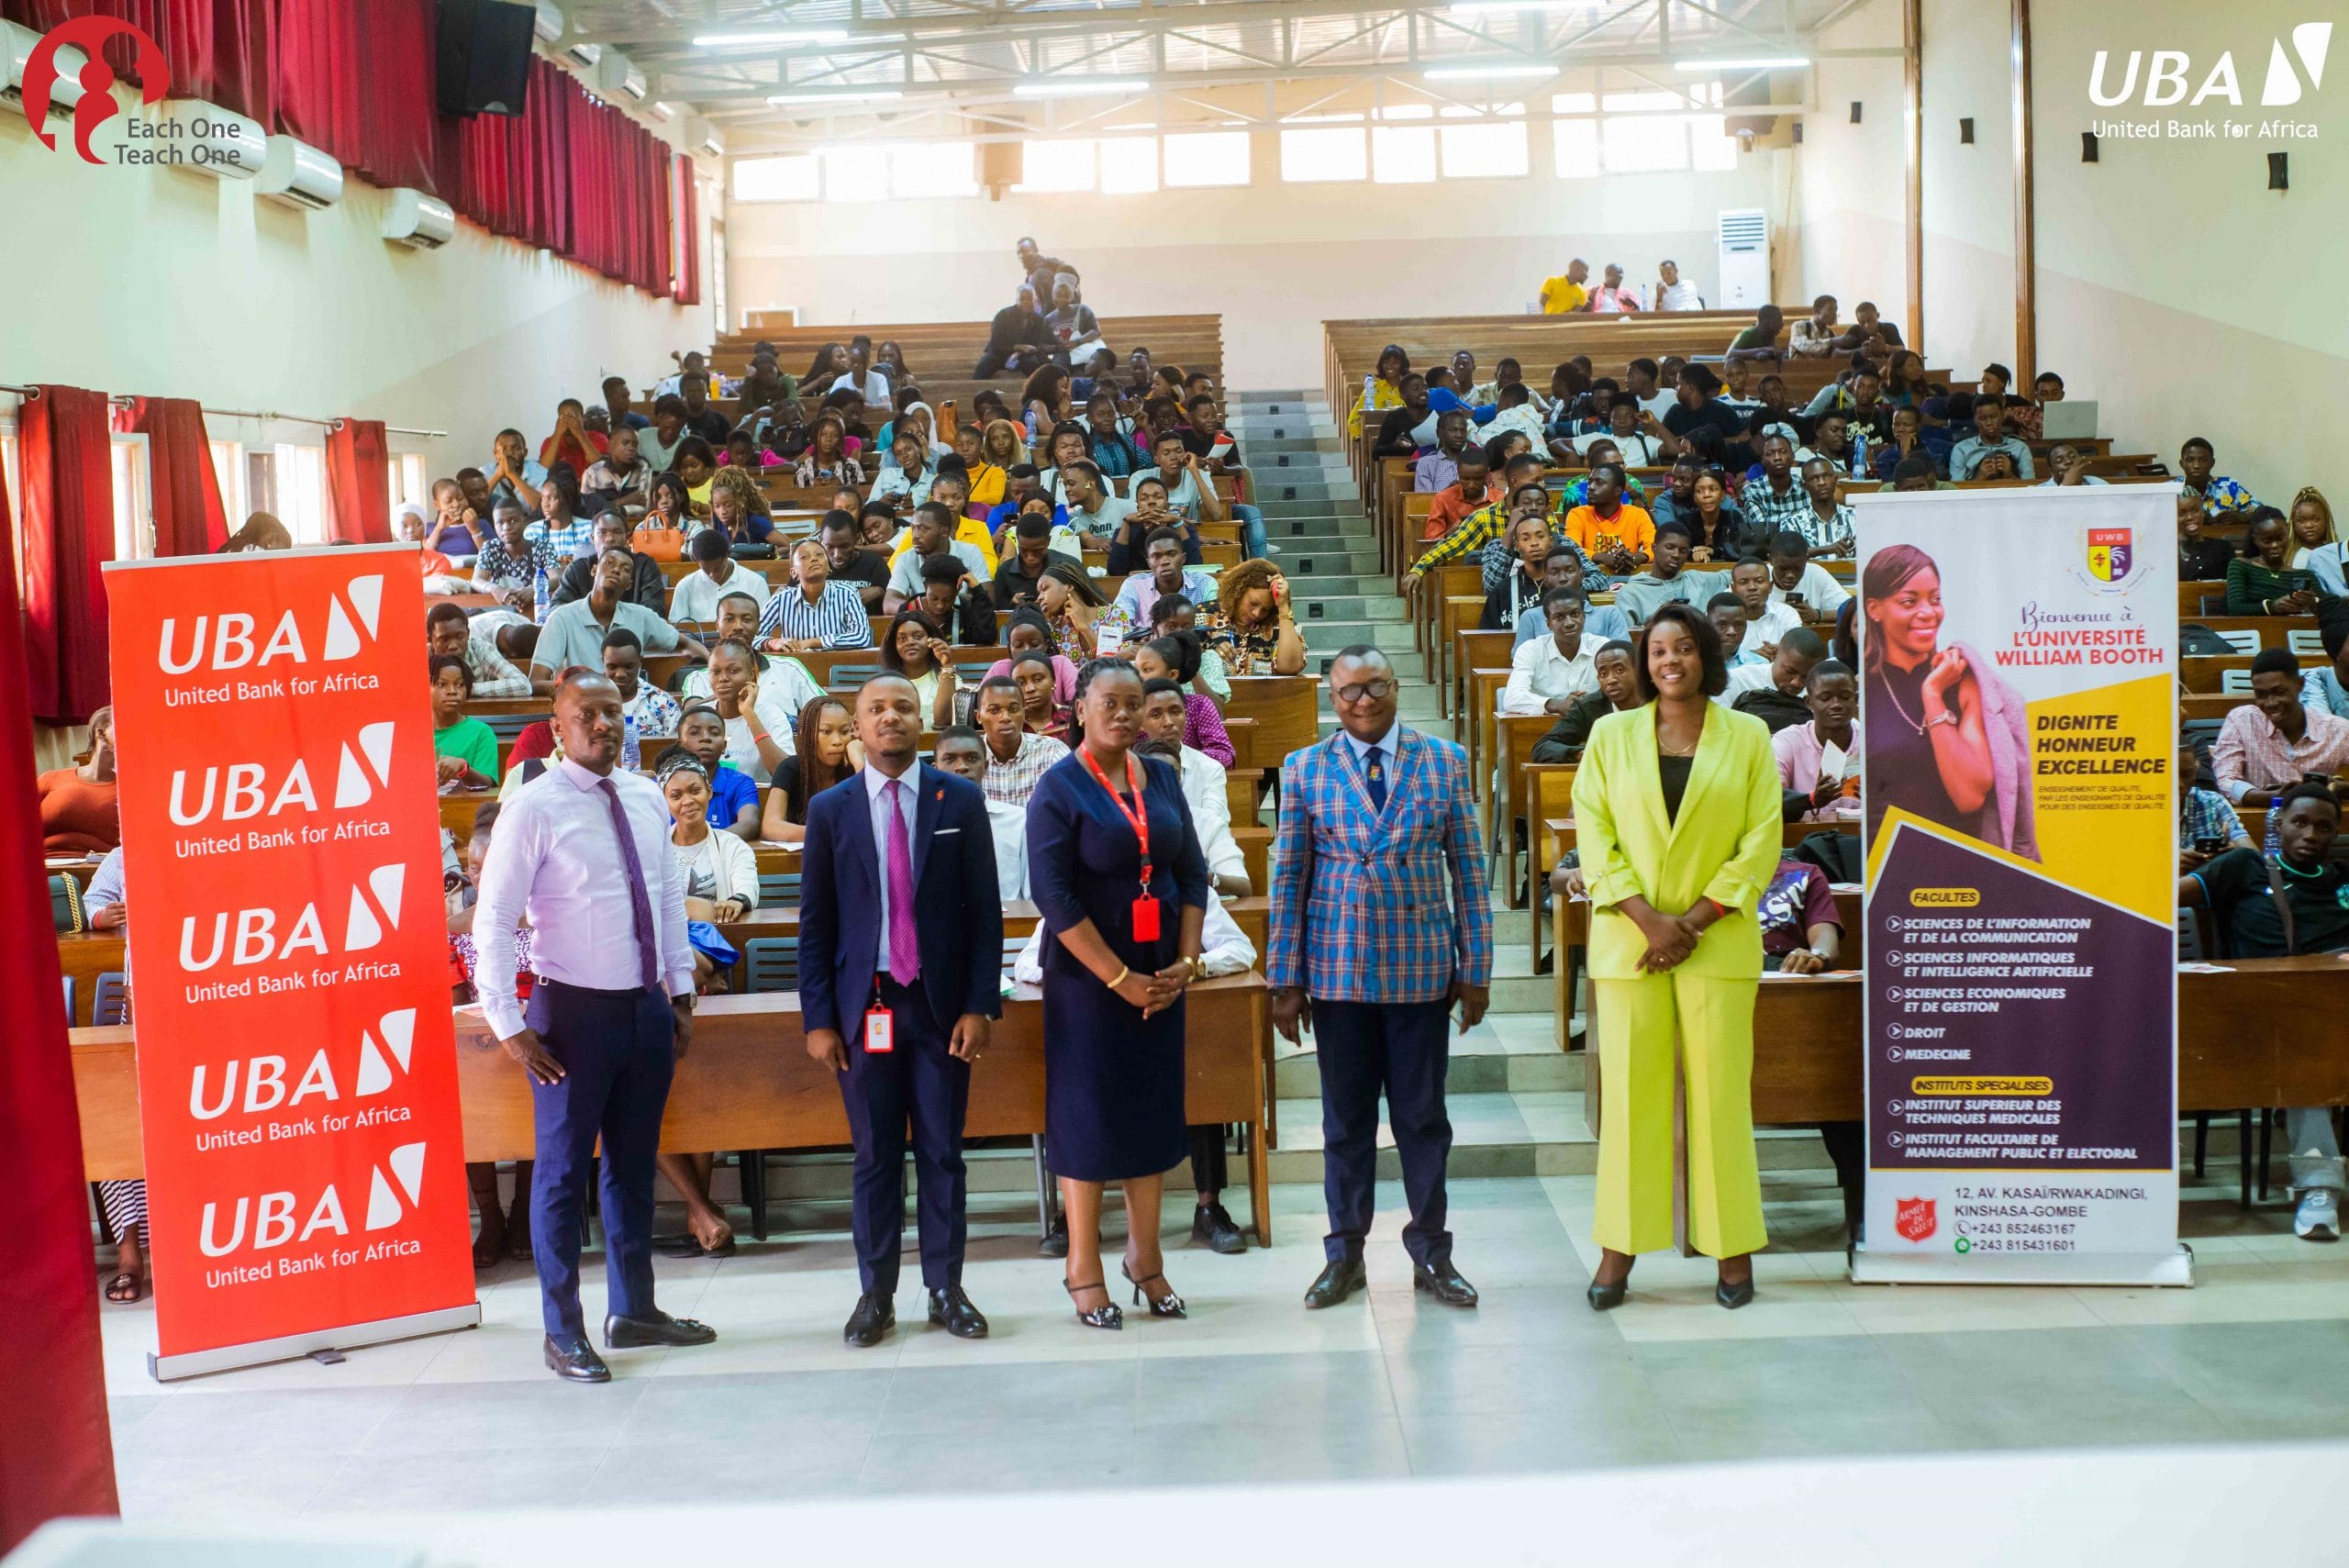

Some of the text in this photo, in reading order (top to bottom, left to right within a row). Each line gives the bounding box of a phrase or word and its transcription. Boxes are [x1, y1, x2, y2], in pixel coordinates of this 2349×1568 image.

[2096, 533, 2124, 541] UWB
[2021, 601, 2135, 633] Bienvenue à
[158, 609, 306, 675] UBA
[1995, 648, 2164, 666] WILLIAM BOOTH
[165, 673, 379, 707] United Bank for Africa
[2036, 715, 2120, 730] DIGNITE
[2036, 737, 2137, 752] HONNEUR
[2036, 759, 2167, 775] EXCELLENCE
[169, 758, 318, 827] UBA
[175, 820, 391, 858] United Bank for Africa
[1913, 891, 1976, 903] FACULTES
[1904, 918, 1964, 929] SCIENCES
[1966, 918, 1984, 929] DE
[179, 902, 329, 973] UBA
[1904, 932, 2078, 943] ET DE LA COMMUNICATION
[1904, 952, 2076, 964] SCIENCES INFORMATIQUES
[1904, 966, 2094, 977] ET INTELLIGENCE ARTIFICIELLE
[185, 962, 401, 1004] United Bank for Africa
[1904, 987, 2066, 1000] SCIENCES ECONOMIQUES
[1904, 1002, 1999, 1013] ET DE GESTION
[1904, 1028, 1946, 1039] DROIT
[1904, 1049, 1971, 1061] MEDECINE
[189, 1048, 340, 1121] UBA
[1915, 1080, 2051, 1091] INSTITUTS SPECIALISES
[1905, 1099, 2062, 1111] INSTITUT SUPERIEUR DES
[1905, 1113, 2061, 1125] TECHNIQUES MEDICALES
[196, 1106, 411, 1152] United Bank for Africa
[1905, 1134, 2059, 1145] INSTITUT FACULTAIRE DE
[1905, 1148, 2138, 1159] MANAGEMENT PUBLIC ET ELECTORAL
[1977, 1188, 1998, 1199] AV.
[1954, 1206, 2087, 1218] KINSHASA-GOMBE
[199, 1184, 350, 1258] UBA
[1972, 1223, 2076, 1235] +243 852463167
[1972, 1240, 2076, 1251] +243 815431601
[206, 1240, 421, 1289] United Bank for Africa
